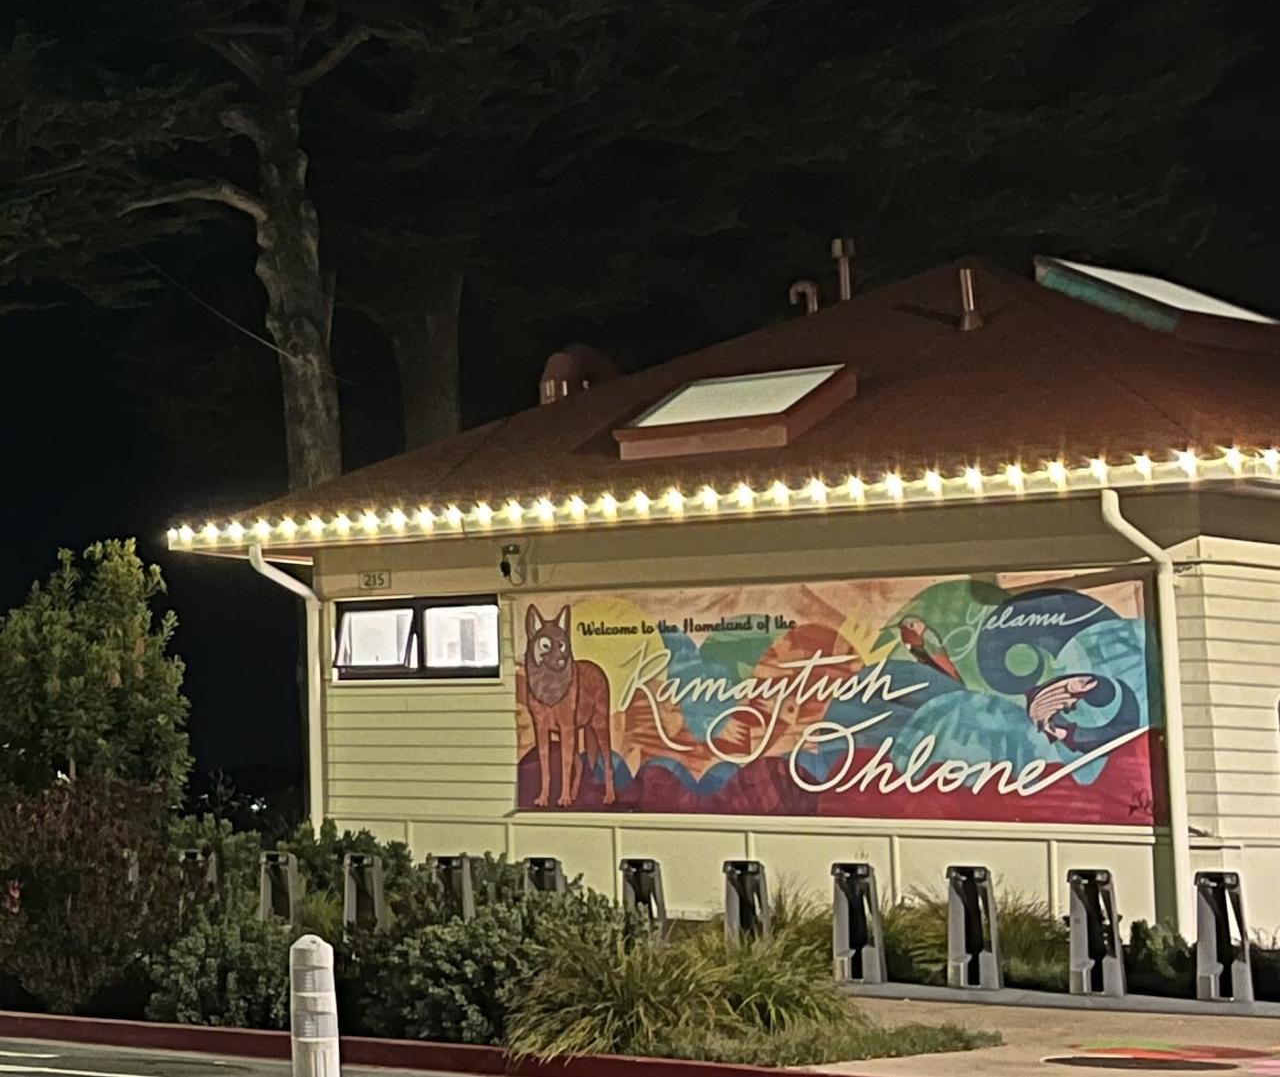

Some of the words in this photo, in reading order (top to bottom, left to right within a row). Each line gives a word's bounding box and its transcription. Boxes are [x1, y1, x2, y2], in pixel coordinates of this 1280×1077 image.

[364, 574, 385, 587] 215
[577, 621, 638, 636] Welcome
[641, 620, 655, 634] to
[657, 620, 679, 634] the
[683, 616, 752, 633] Homeland
[756, 615, 770, 633] of
[774, 615, 797, 630] the
[618, 640, 930, 764] Ramaytush
[790, 710, 1150, 797] Ohlone
